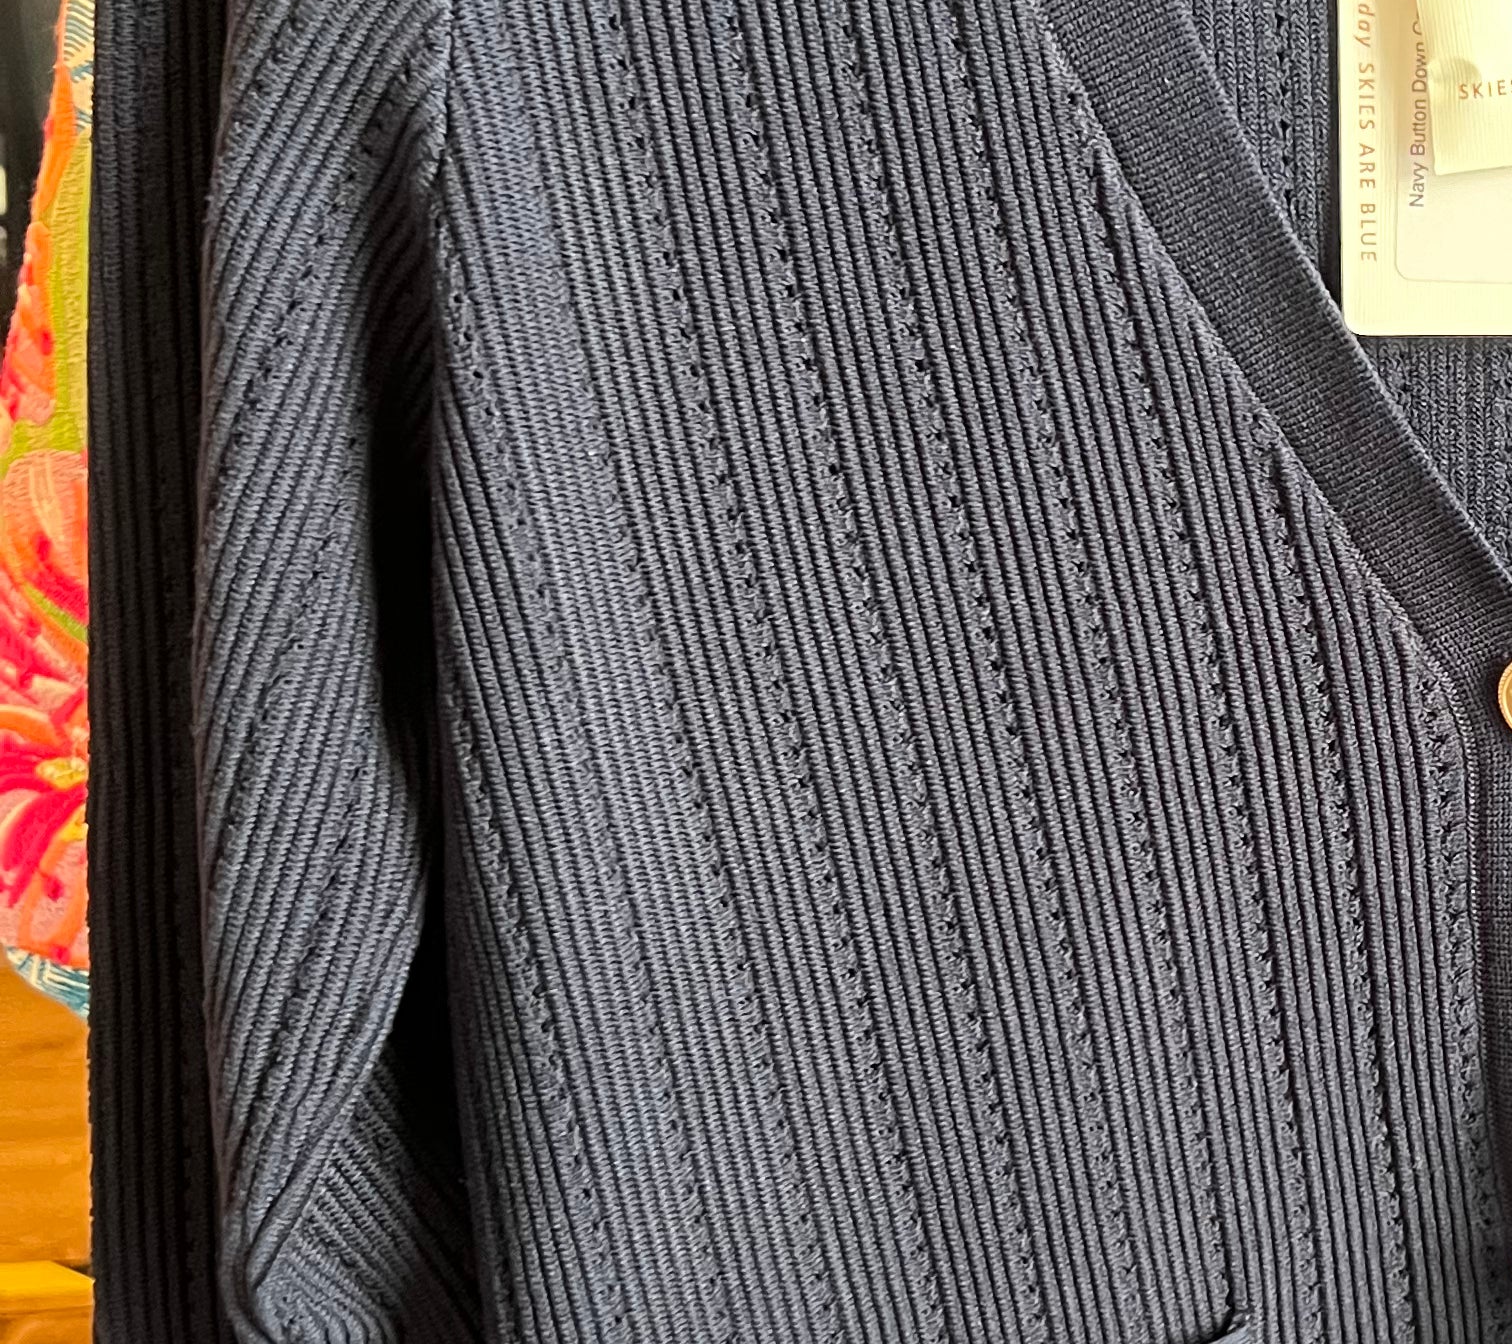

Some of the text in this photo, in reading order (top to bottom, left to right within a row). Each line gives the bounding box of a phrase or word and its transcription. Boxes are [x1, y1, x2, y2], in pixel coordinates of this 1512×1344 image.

[1411, 41, 1428, 93] Down
[1358, 62, 1375, 130] SKIES
[1410, 99, 1427, 156] Button
[1359, 143, 1376, 189] ARE
[1408, 162, 1429, 208] Navy
[1360, 203, 1377, 262] BLUE
